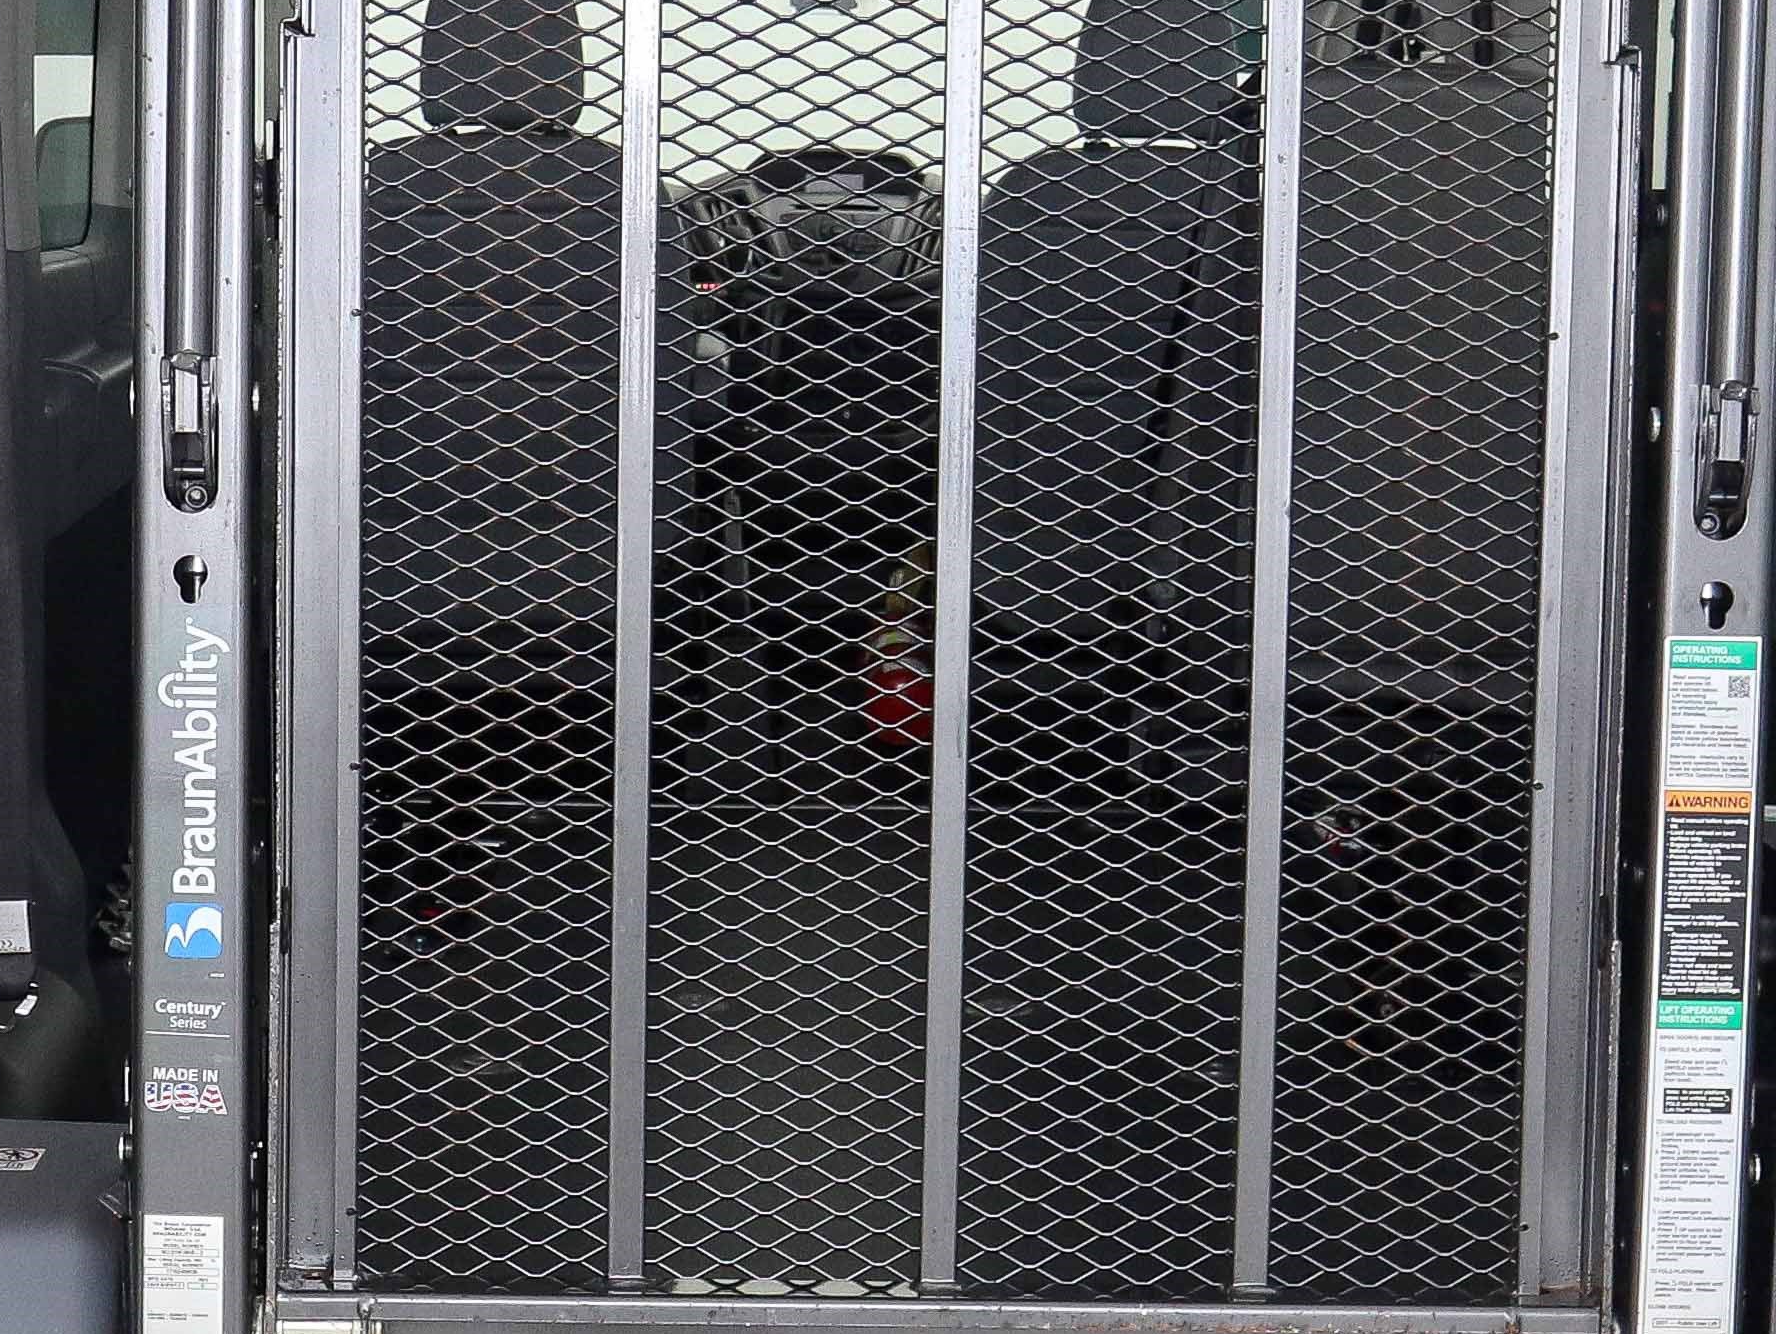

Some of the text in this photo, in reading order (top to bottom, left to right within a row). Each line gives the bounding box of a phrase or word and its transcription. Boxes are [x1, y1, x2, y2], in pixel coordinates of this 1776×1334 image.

[158, 619, 231, 895] BraunAbility
[1682, 795, 1749, 809] WARNING
[155, 998, 225, 1019] Century
[170, 1016, 207, 1029] Series
[153, 1067, 219, 1082] MADE IN
[144, 1081, 228, 1115] USA
